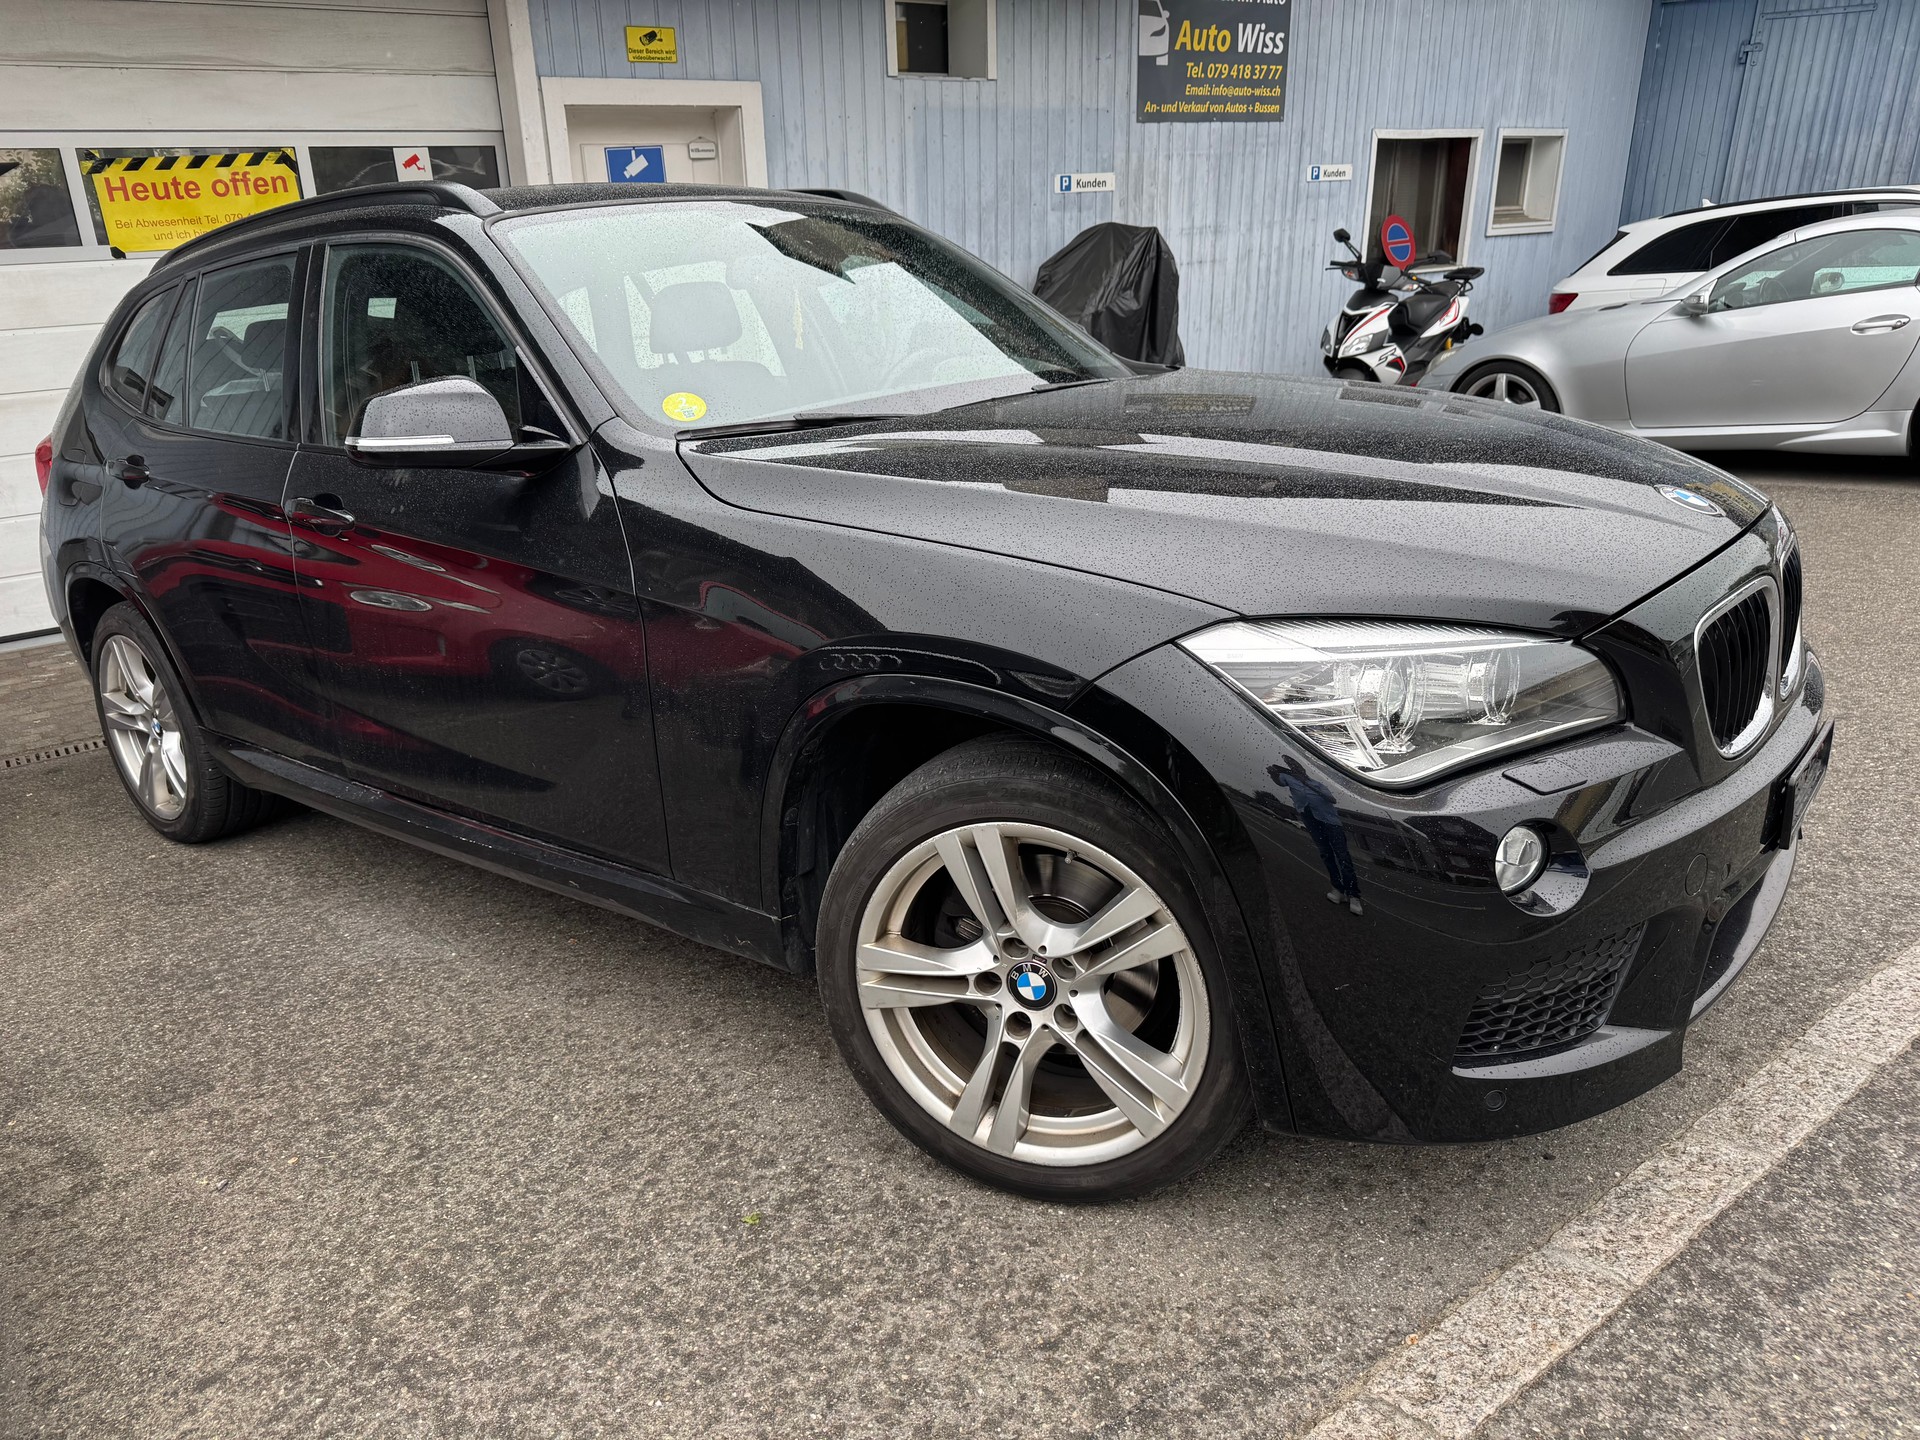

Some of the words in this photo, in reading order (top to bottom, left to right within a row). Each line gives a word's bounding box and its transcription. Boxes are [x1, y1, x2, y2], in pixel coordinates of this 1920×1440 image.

[1174, 20, 1231, 52] Auto
[1237, 22, 1285, 54] Wiss
[1186, 62, 1205, 78] Tel.
[1207, 63, 1229, 79] 079
[1230, 64, 1251, 79] 418
[1252, 64, 1267, 79] 37
[1268, 65, 1283, 80] 77
[1185, 83, 1211, 96] Email:
[1211, 84, 1281, 97] info@auto-wiss.ch
[1144, 101, 1160, 113] An-
[1161, 101, 1178, 113] und
[1178, 101, 1210, 113] Verkauf
[1209, 104, 1224, 113] von
[1224, 101, 1247, 113] Autos
[1247, 104, 1254, 112] +
[1254, 102, 1280, 114] Bussen
[1323, 168, 1346, 178] Kunden
[104, 176, 201, 203] Heute
[211, 171, 289, 197] offen
[1076, 178, 1107, 188] Kunden
[115, 219, 133, 229] Bei
[136, 216, 202, 228] Abwesenheit
[204, 214, 222, 224] Tel.
[153, 231, 173, 240] und
[176, 230, 191, 239] ich
[1011, 963, 1048, 980] BMW
